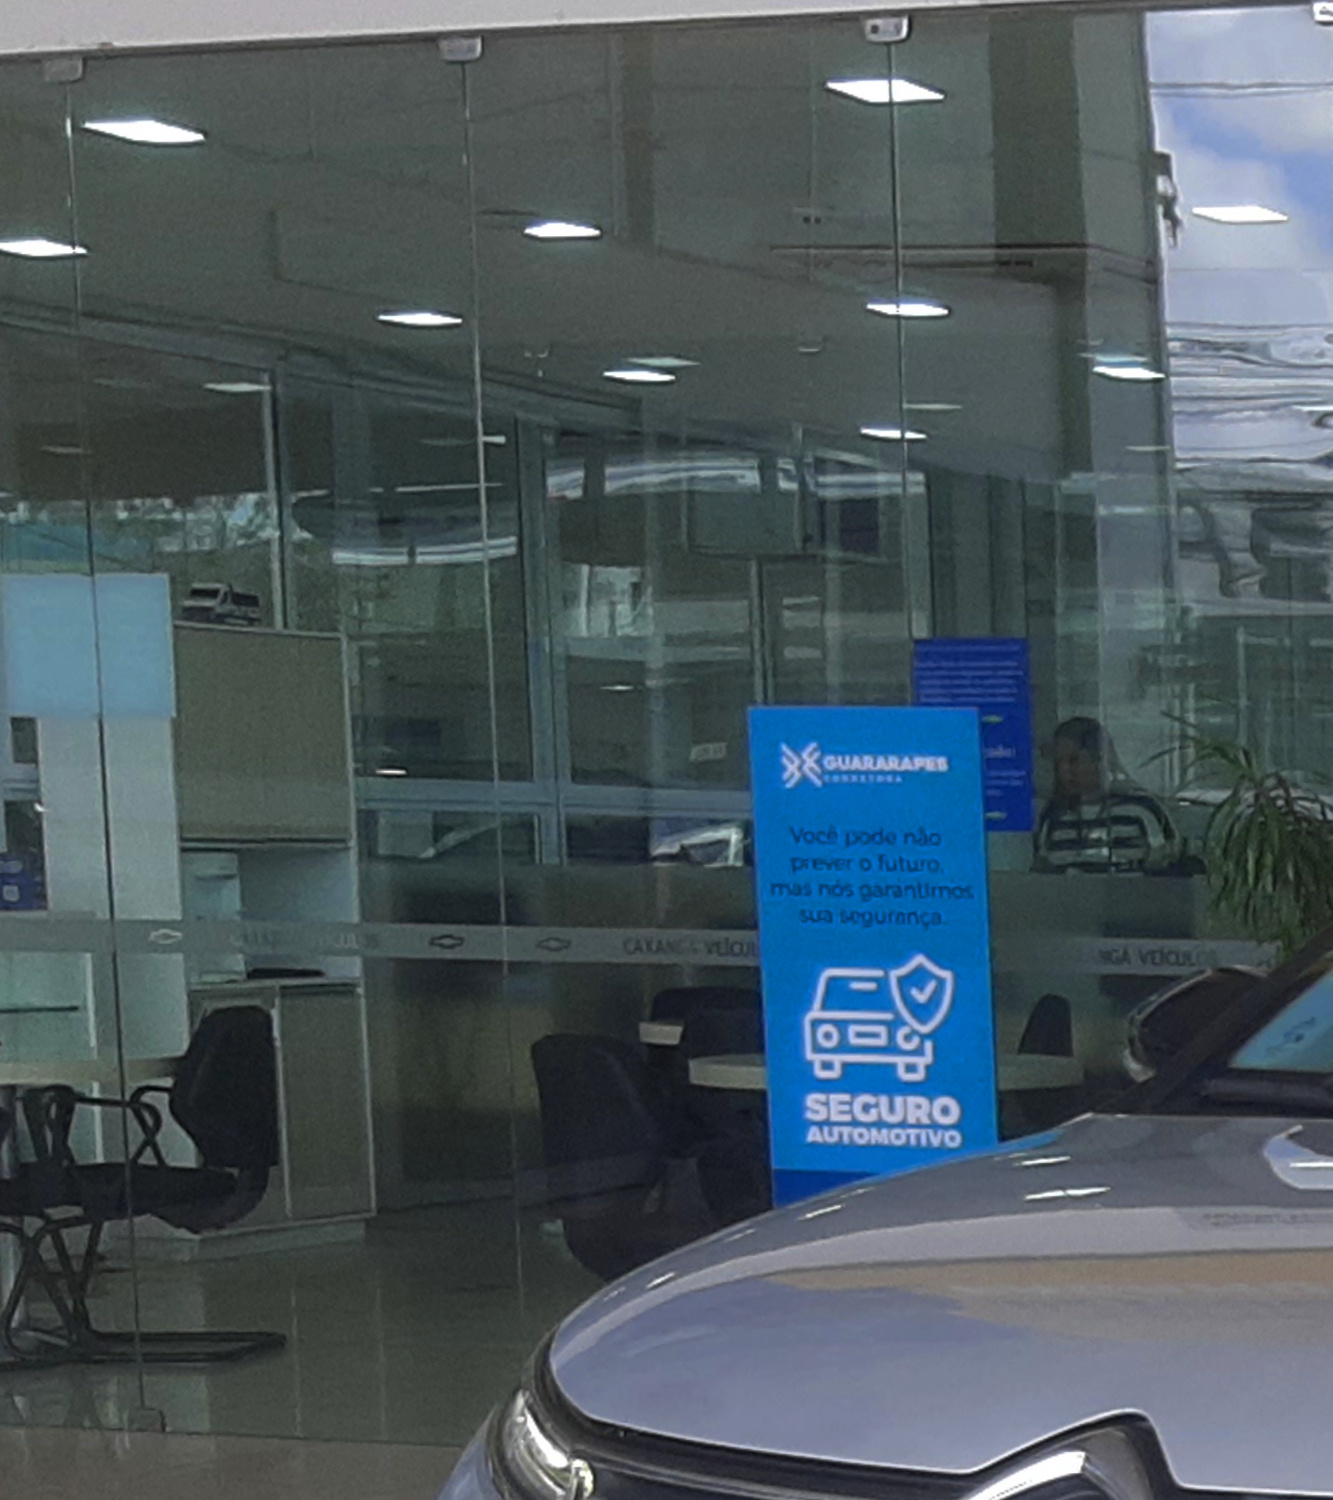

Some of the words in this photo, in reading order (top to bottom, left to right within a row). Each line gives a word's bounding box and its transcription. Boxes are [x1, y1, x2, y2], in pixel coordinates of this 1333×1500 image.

[822, 754, 949, 773] GUARARAPES
[790, 824, 838, 846] Você
[845, 827, 897, 850] pode
[903, 827, 942, 846] não
[791, 857, 853, 875] prever
[859, 858, 872, 872] o
[770, 882, 813, 897] mas
[818, 879, 855, 897] nós
[859, 880, 975, 903] garantimos
[799, 908, 834, 925] sua
[840, 908, 946, 929] segurança.
[805, 1093, 961, 1125] SEGURO
[805, 1126, 962, 1147] AUTOMOTIVO
